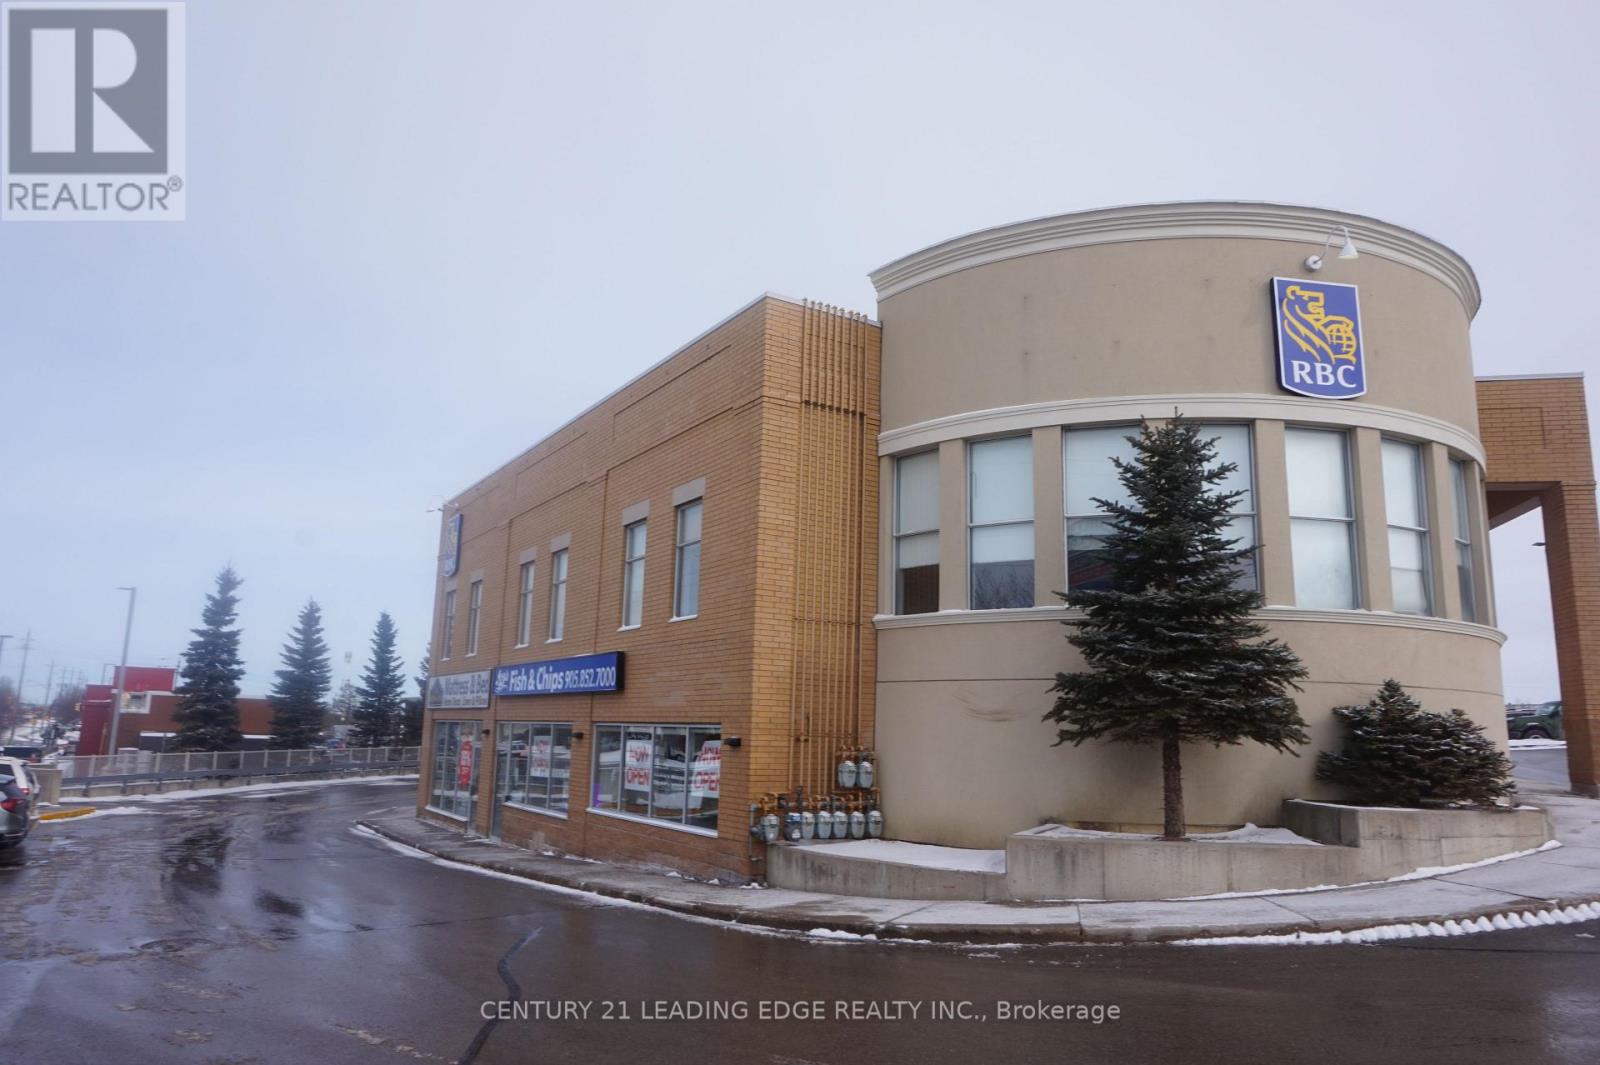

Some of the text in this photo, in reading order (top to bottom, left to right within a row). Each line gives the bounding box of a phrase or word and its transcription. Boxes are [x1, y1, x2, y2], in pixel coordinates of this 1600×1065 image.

[1291, 360, 1357, 388] RBC
[509, 668, 527, 691] Fish
[528, 669, 536, 691] &
[537, 665, 564, 693] Chips
[565, 666, 616, 689] 905.852.7000
[626, 769, 650, 786] OPEN
